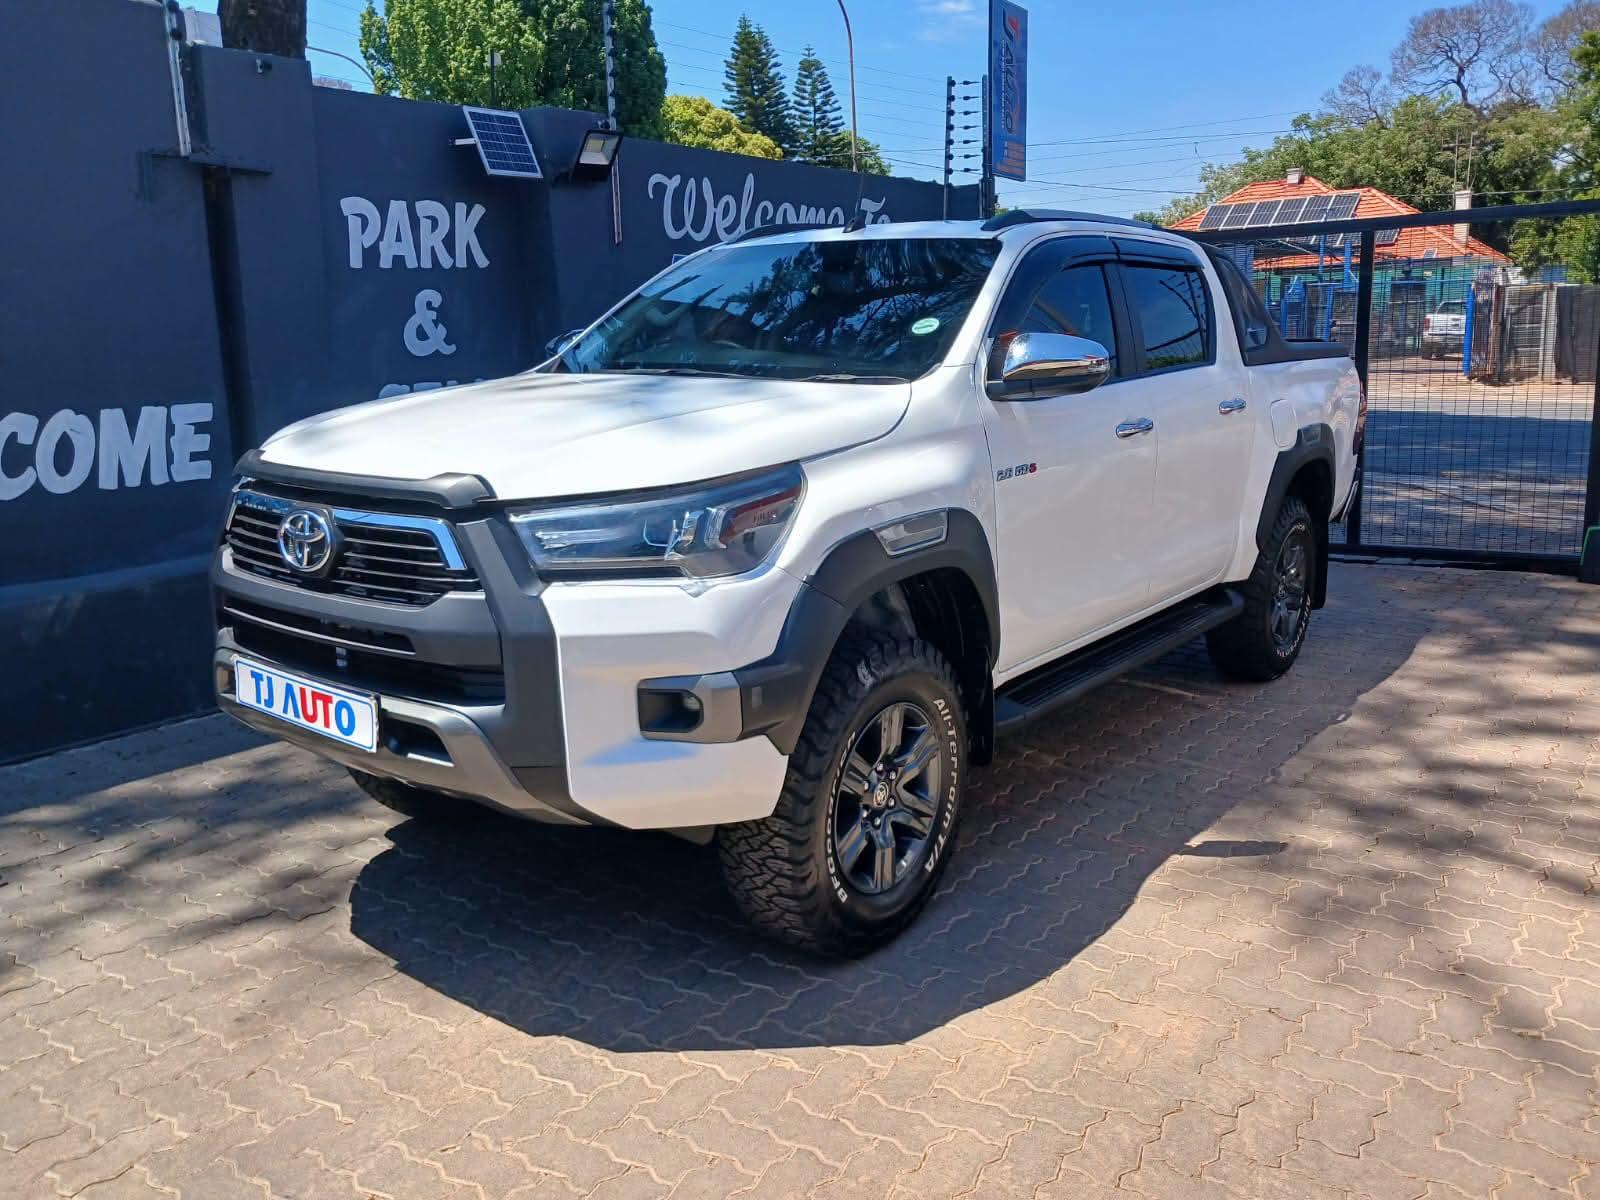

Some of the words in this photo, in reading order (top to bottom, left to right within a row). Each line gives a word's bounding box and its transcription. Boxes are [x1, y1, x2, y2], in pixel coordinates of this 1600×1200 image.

[339, 196, 490, 270] PARK
[403, 288, 457, 357] &
[0, 402, 214, 501] COME
[250, 669, 275, 709] TJ
[282, 681, 356, 737] AUTO
[932, 698, 958, 829] All-Terrain
[924, 834, 946, 873] T/A
